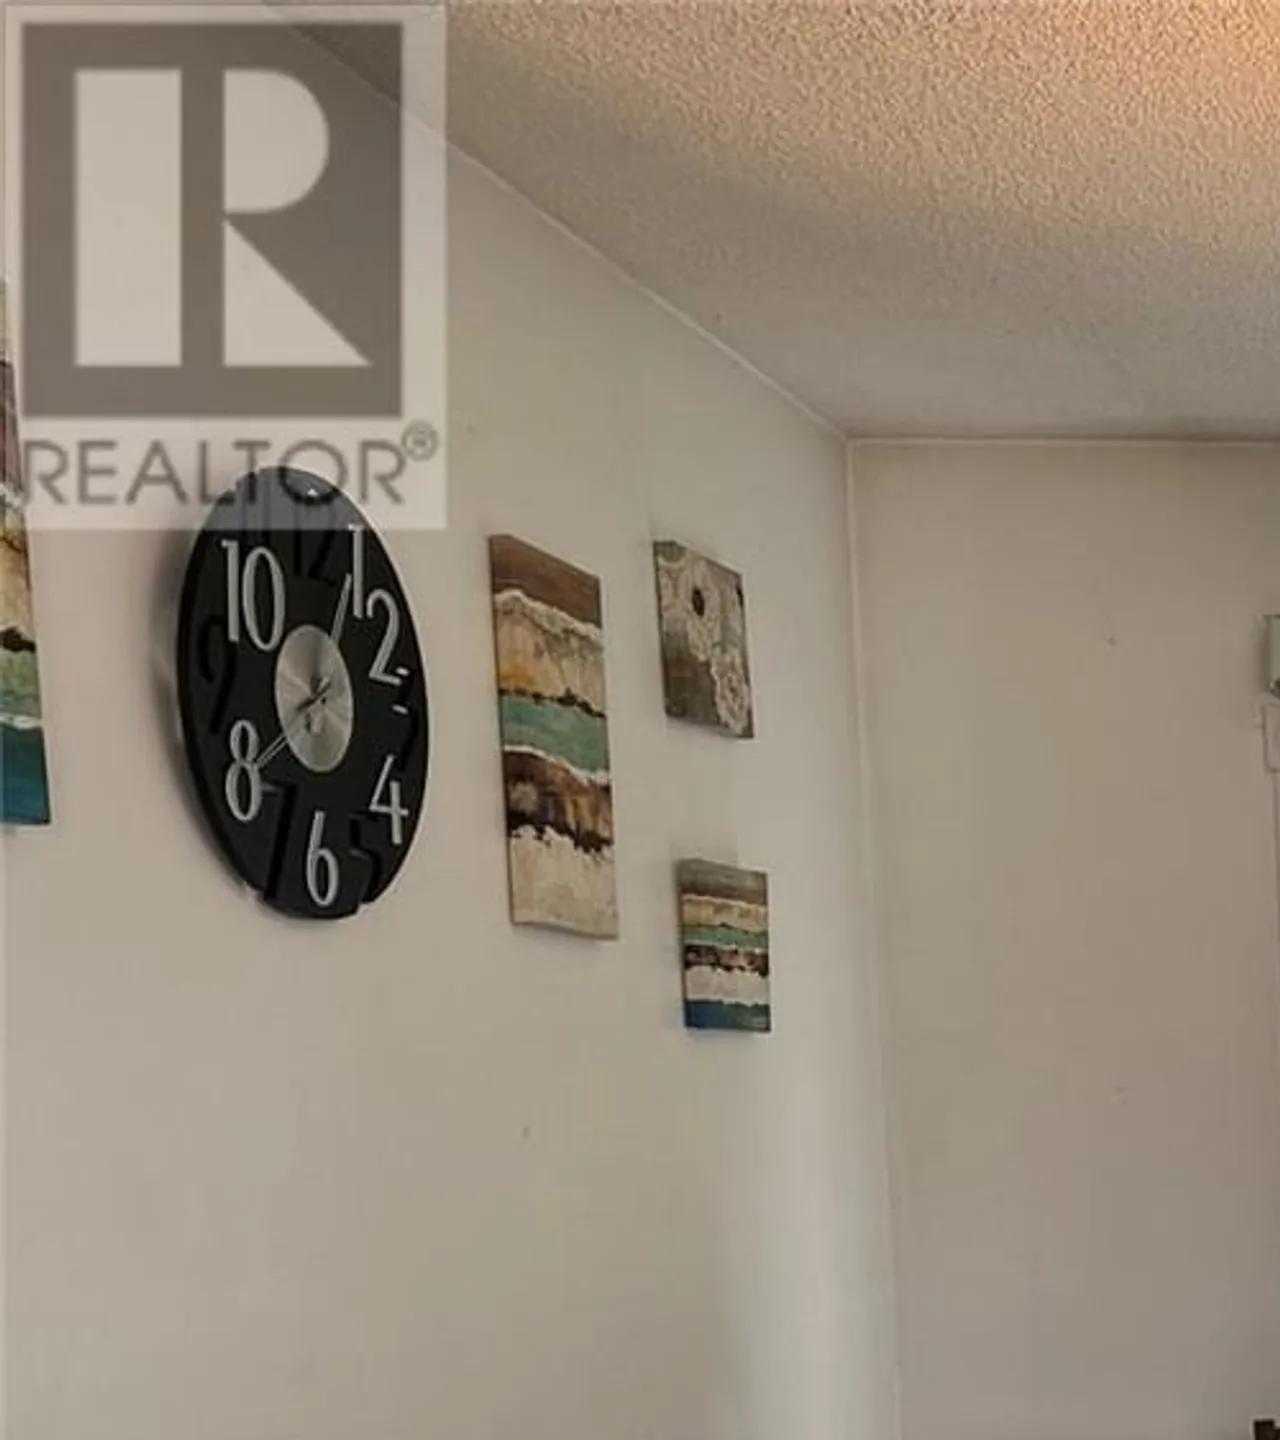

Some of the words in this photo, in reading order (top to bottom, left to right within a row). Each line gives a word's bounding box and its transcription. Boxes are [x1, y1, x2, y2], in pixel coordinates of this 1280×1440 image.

[221, 539, 286, 651] 10
[366, 588, 402, 686] 2
[225, 719, 263, 821] 8
[368, 754, 410, 846] 4
[305, 811, 339, 907] 6
